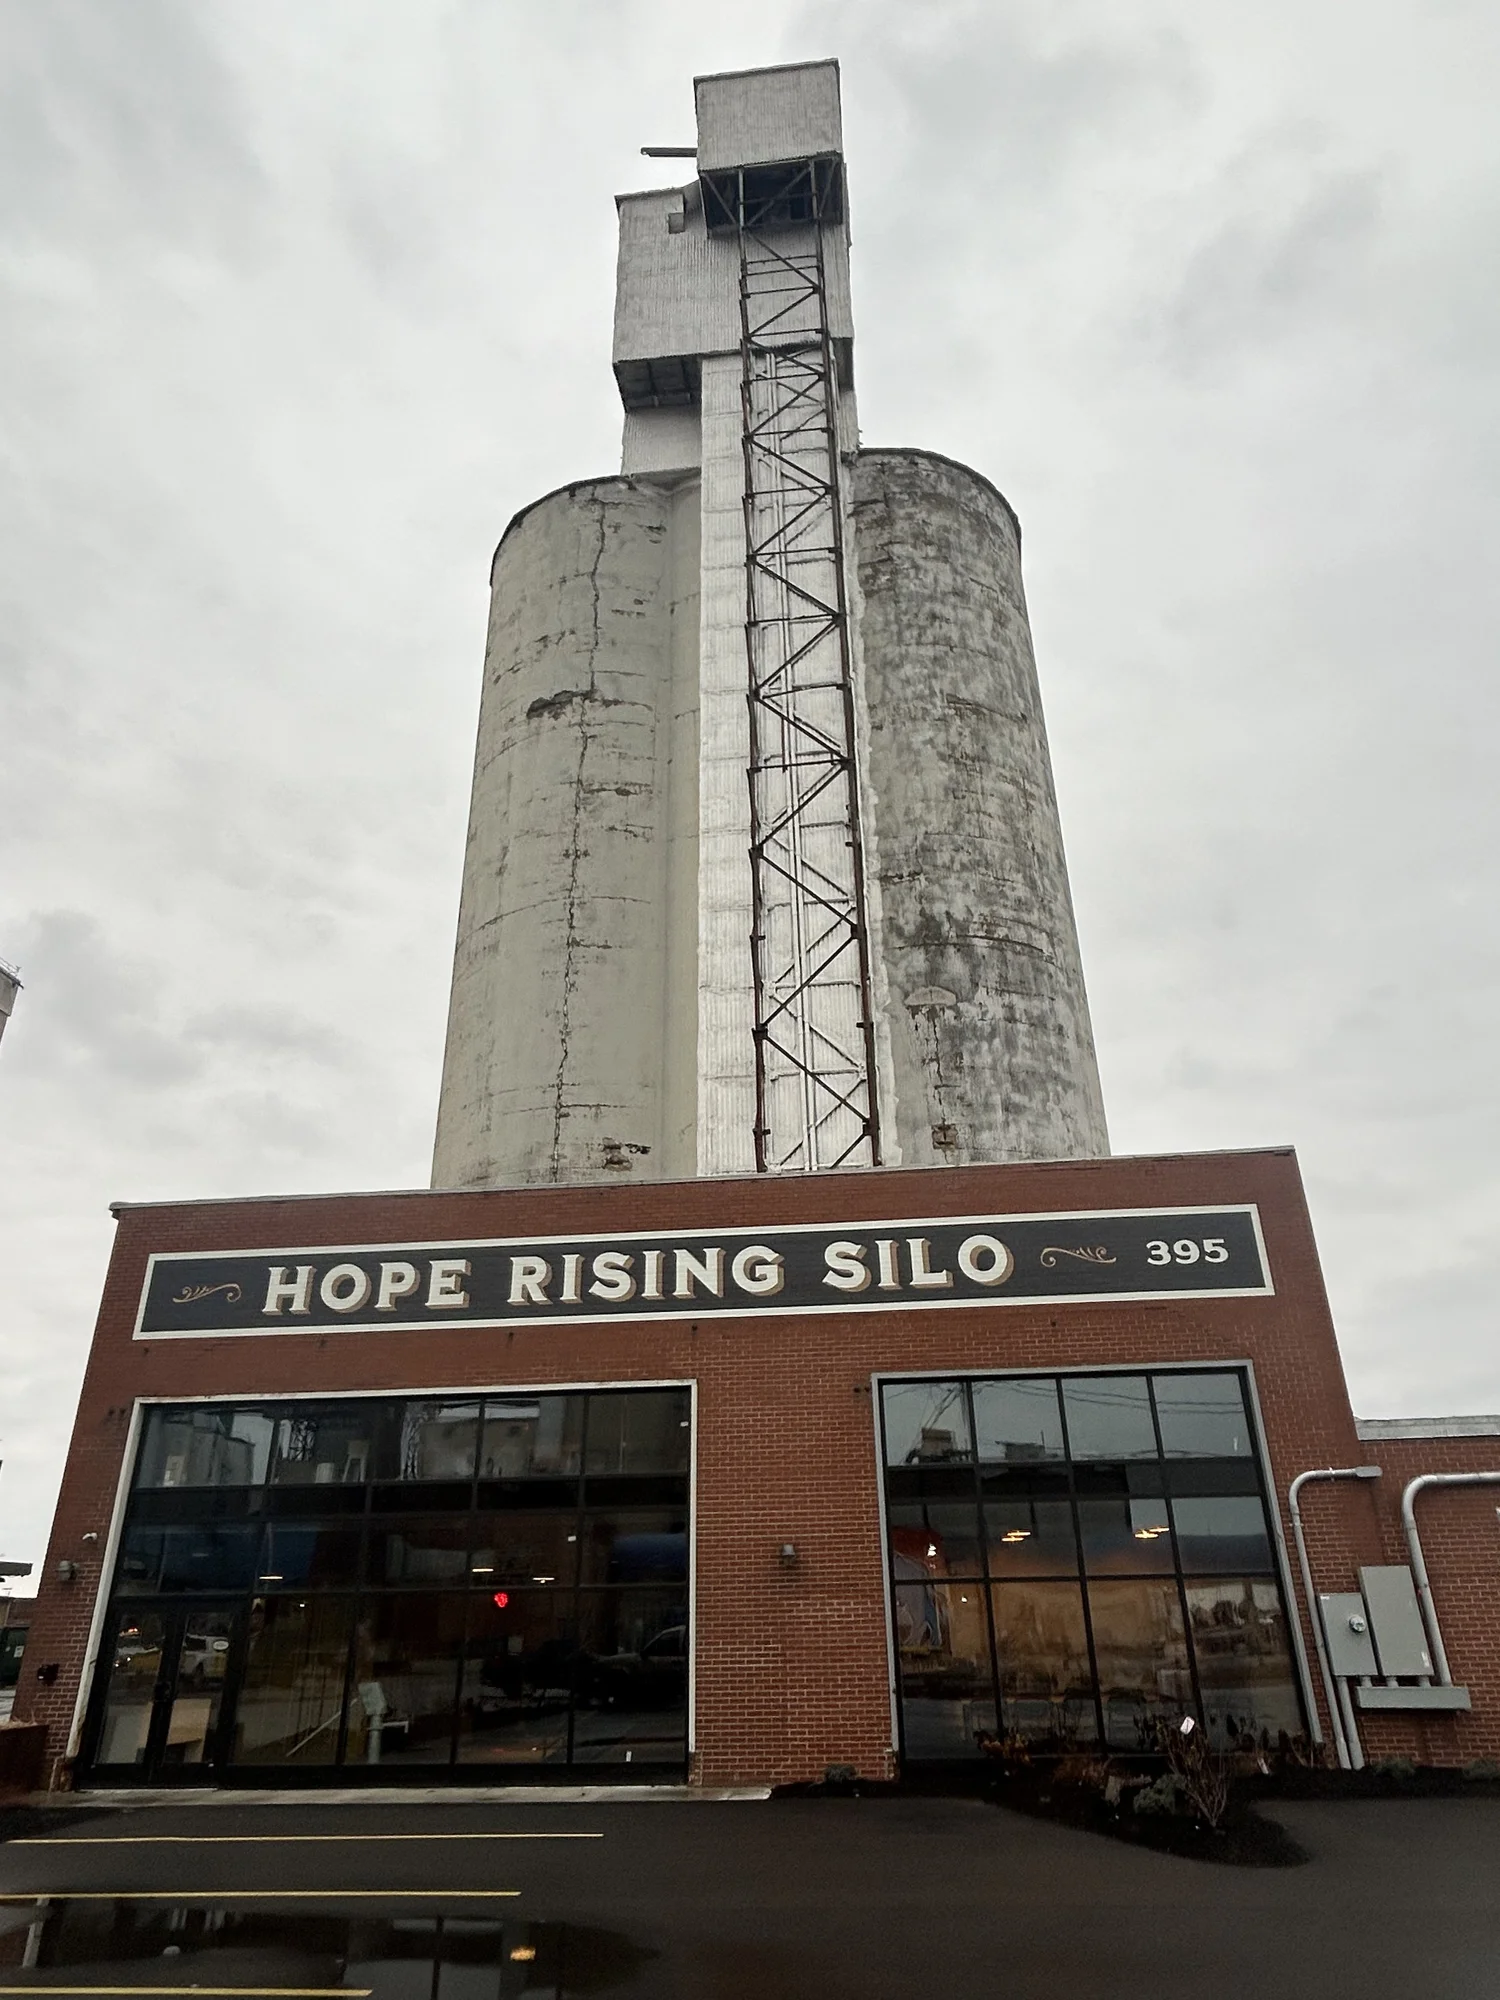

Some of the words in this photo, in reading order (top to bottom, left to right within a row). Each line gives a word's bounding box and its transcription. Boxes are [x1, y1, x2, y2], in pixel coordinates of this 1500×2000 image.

[262, 1260, 472, 1315] HOPE
[508, 1246, 786, 1305] RISING
[822, 1235, 1014, 1293] SILO
[1145, 1238, 1229, 1266] 395
